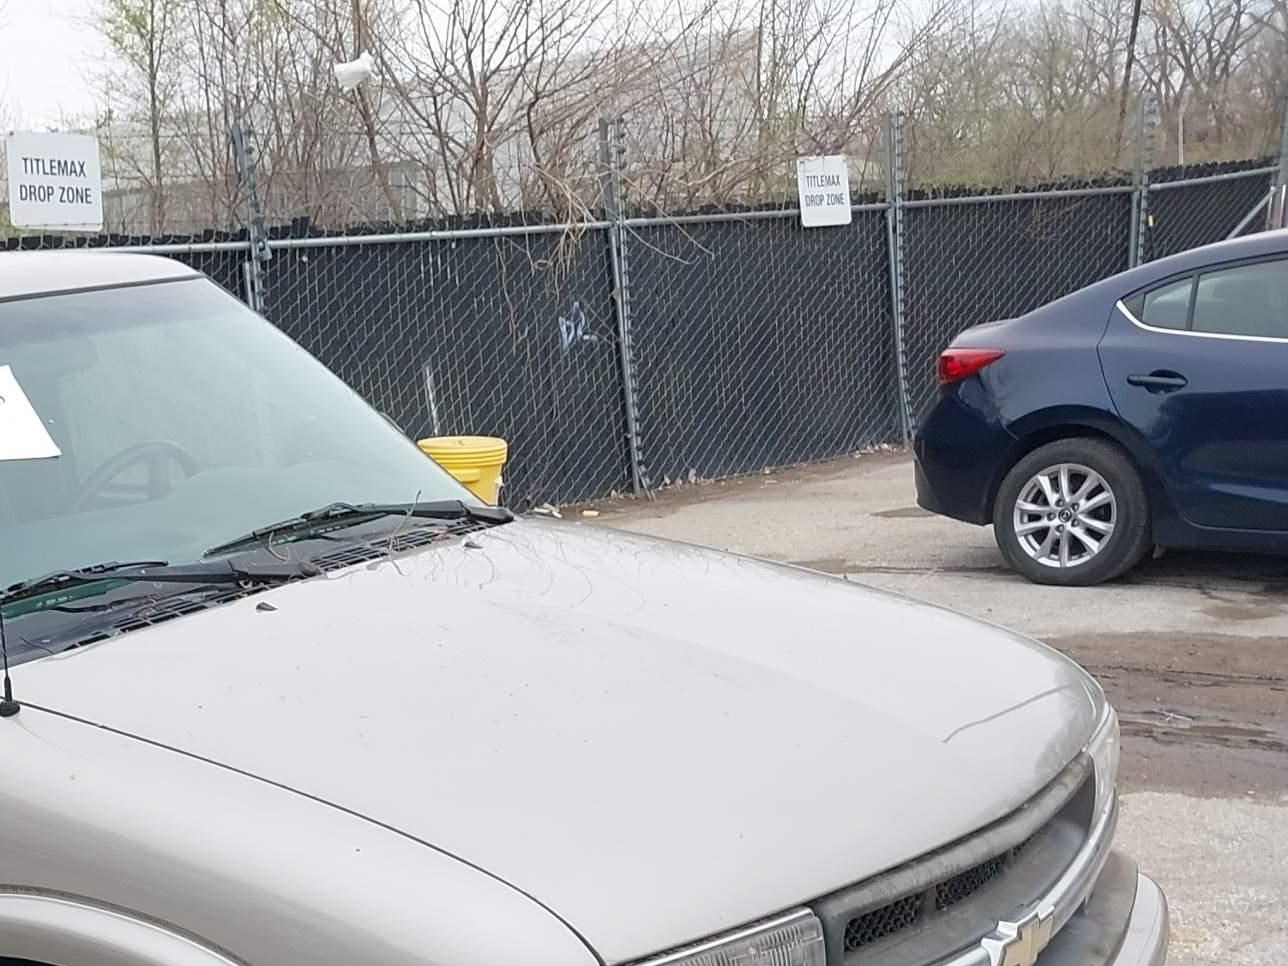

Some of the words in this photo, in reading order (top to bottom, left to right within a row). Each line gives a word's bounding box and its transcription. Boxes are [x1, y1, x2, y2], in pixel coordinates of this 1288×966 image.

[22, 157, 87, 178] TITLEMAX
[806, 175, 841, 188] TITLEMAX
[19, 184, 54, 203] DROP
[58, 186, 92, 204] ZONE
[805, 193, 825, 207] DROP
[826, 192, 845, 206] ZONE
